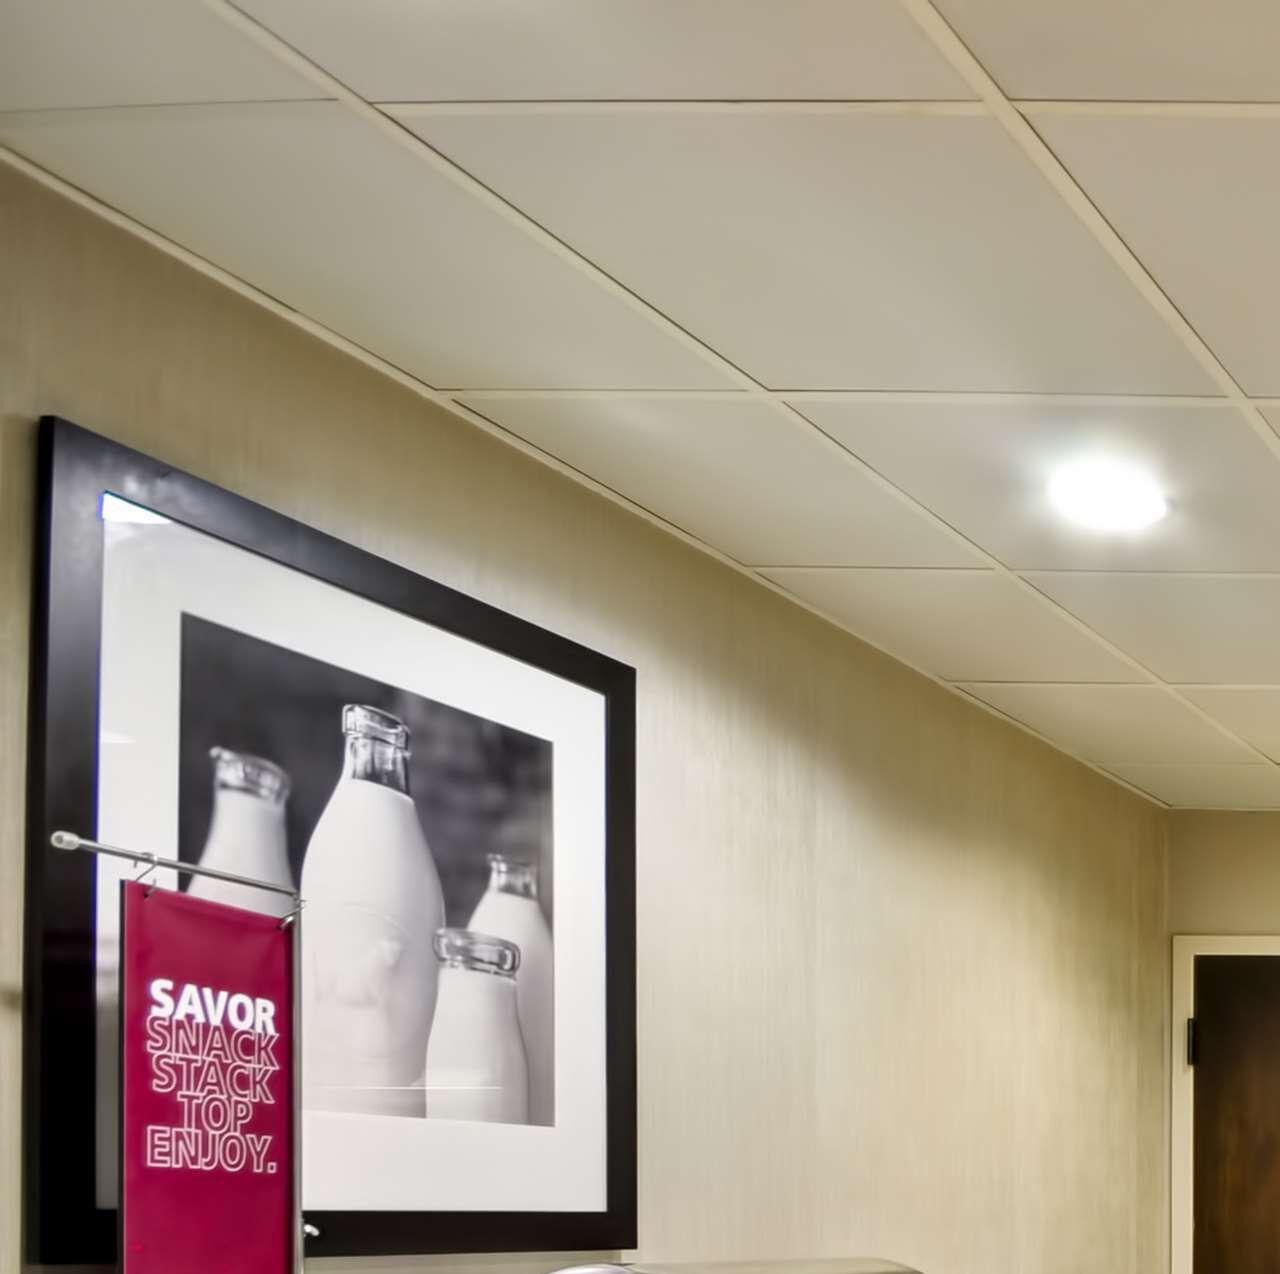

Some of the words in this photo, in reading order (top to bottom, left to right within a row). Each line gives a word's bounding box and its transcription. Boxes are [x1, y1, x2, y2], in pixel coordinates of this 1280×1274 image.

[151, 979, 276, 1036] SAVOR
[147, 1015, 280, 1070] SNACK
[152, 1053, 275, 1104] STACK
[177, 1091, 252, 1136] TOP
[147, 1125, 278, 1173] ENJOY.
